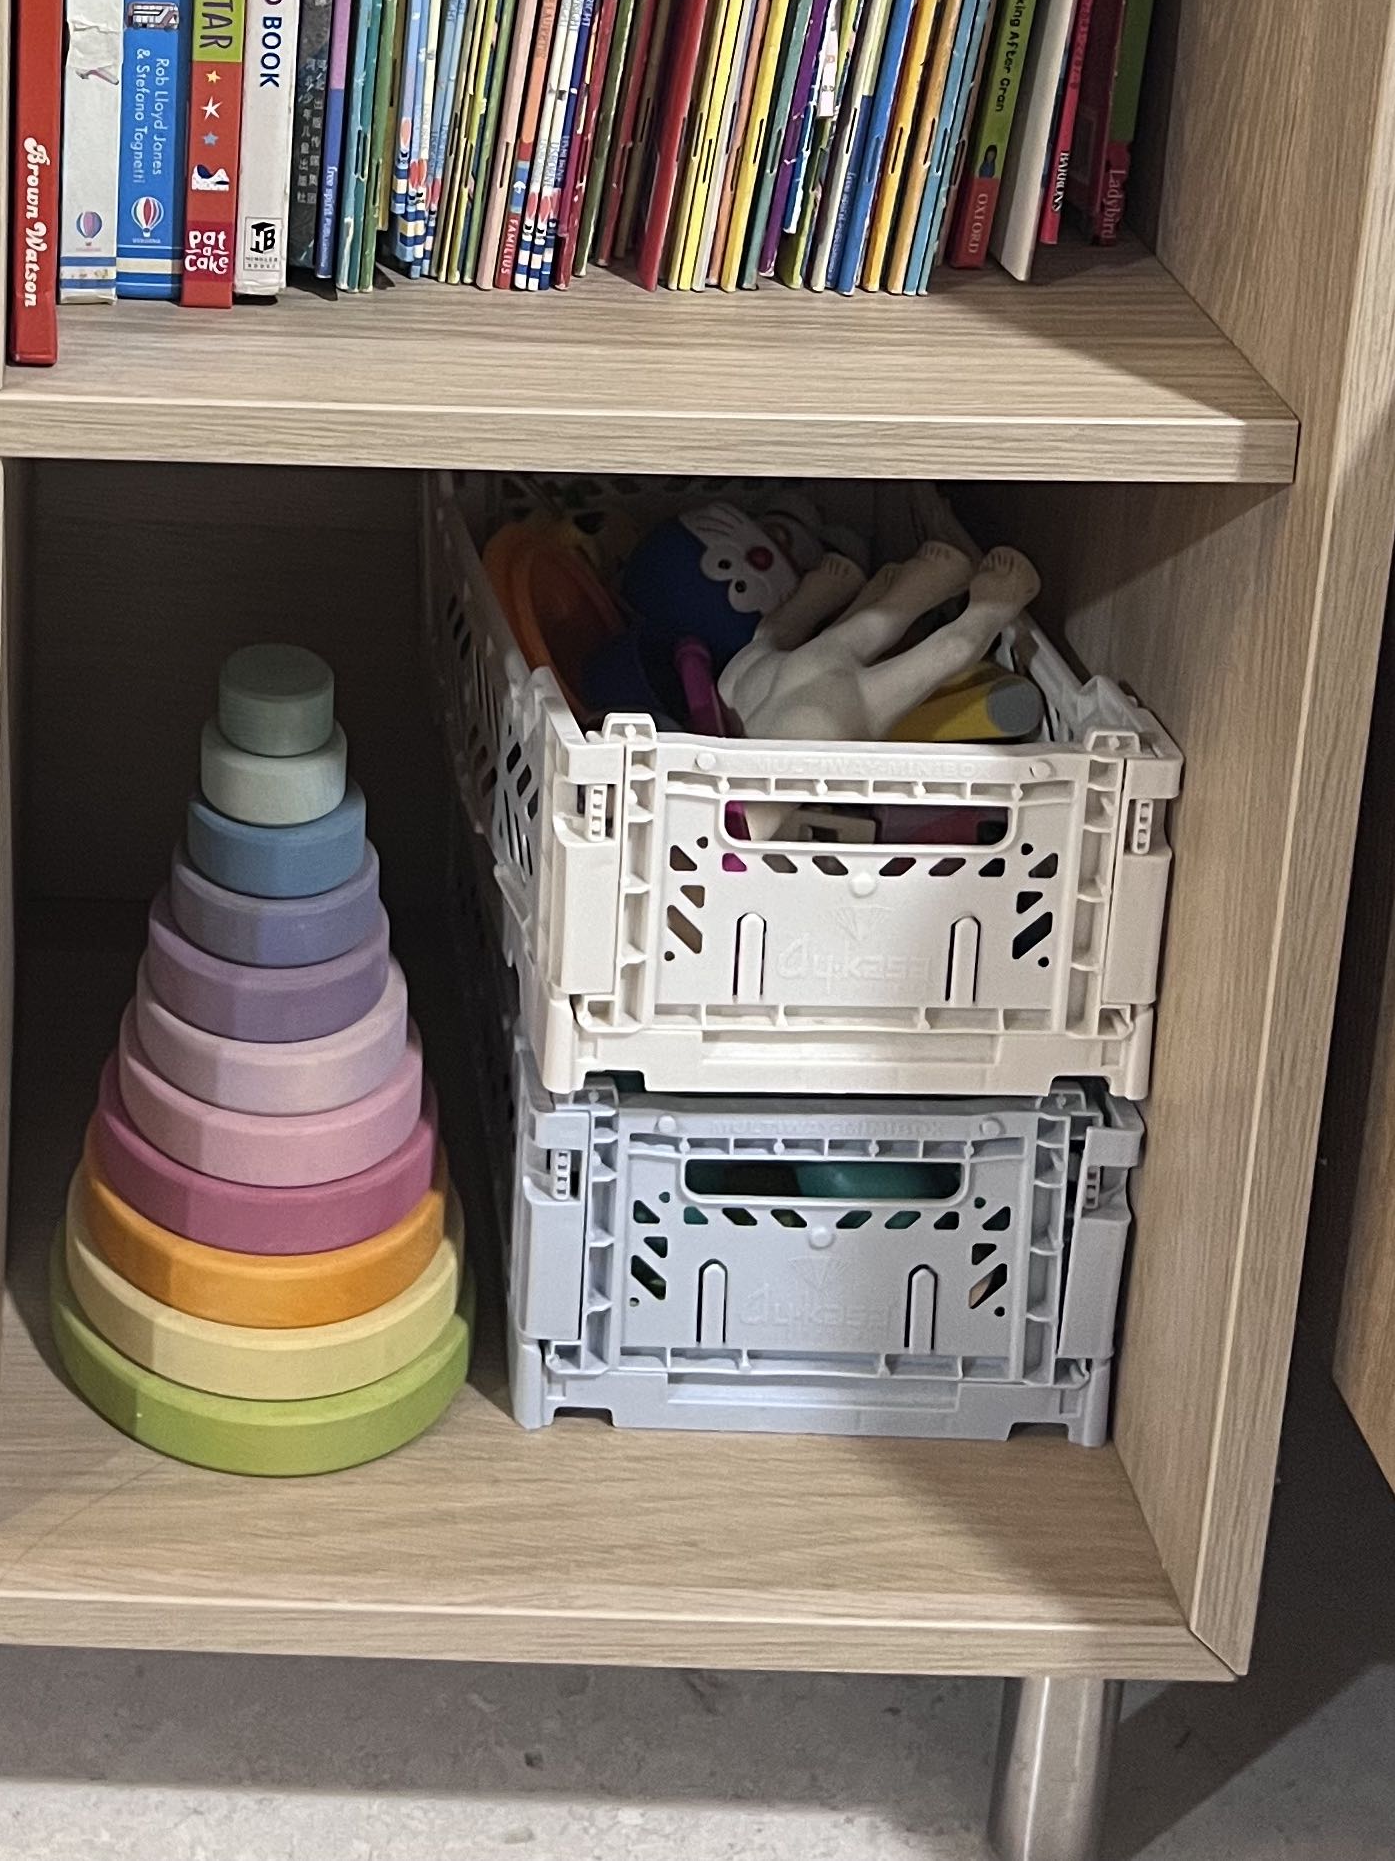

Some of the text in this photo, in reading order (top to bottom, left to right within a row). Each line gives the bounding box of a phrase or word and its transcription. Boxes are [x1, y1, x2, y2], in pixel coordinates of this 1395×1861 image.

[136, 48, 151, 60] &
[258, 15, 282, 89] BOOK
[1000, 31, 1020, 73] After
[134, 65, 150, 122] Stefano
[151, 58, 170, 176] Rob Lloyd Jones
[993, 77, 1011, 112] Gran
[322, 188, 336, 215] spirit
[324, 165, 338, 185] free
[1100, 168, 1127, 238] Ladybird
[22, 136, 51, 308] Brown Watson
[500, 218, 518, 274] FAMILIUS
[966, 193, 988, 253] OXFORD
